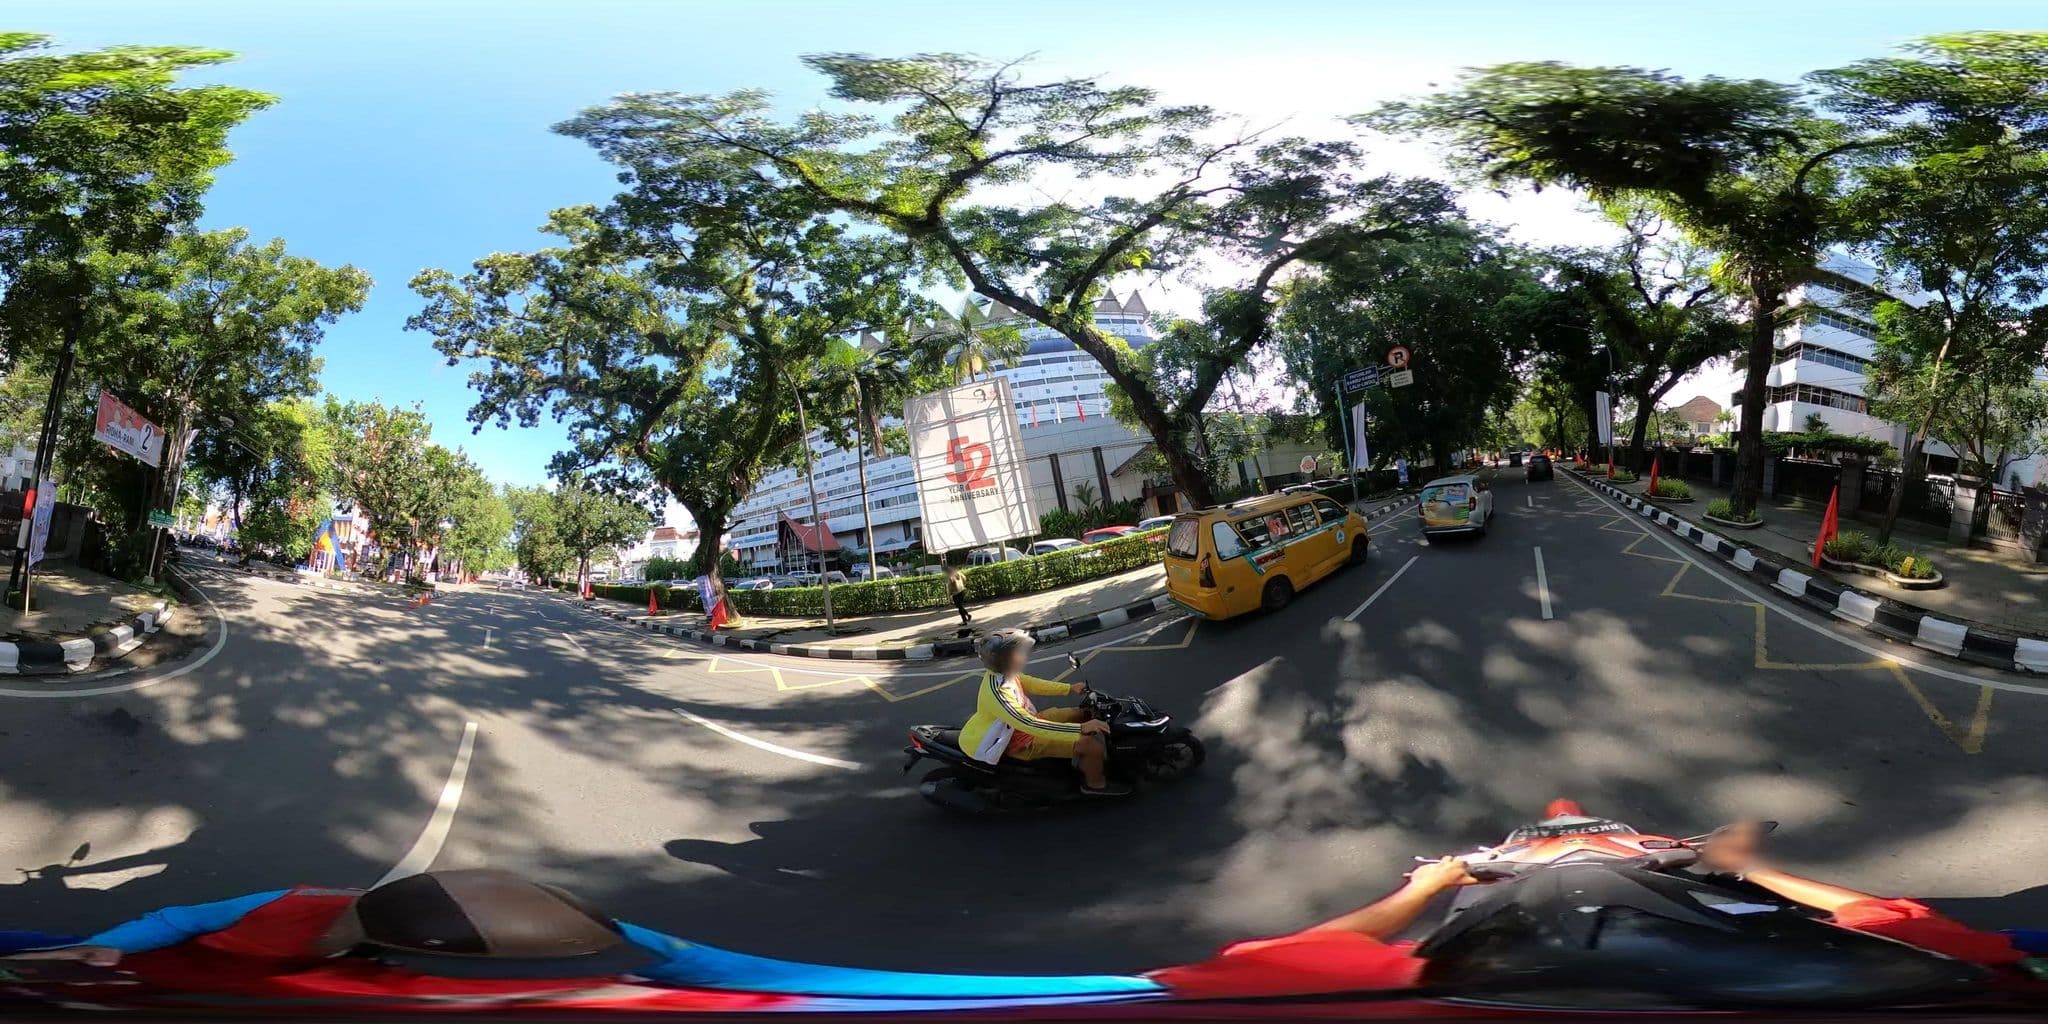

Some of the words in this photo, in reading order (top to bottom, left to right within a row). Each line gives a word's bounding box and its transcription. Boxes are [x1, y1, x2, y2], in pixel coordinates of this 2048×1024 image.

[142, 424, 152, 451] 2
[944, 436, 995, 491] 52
[949, 484, 965, 494] YEAR
[950, 487, 999, 504] ANNIVERSARY
